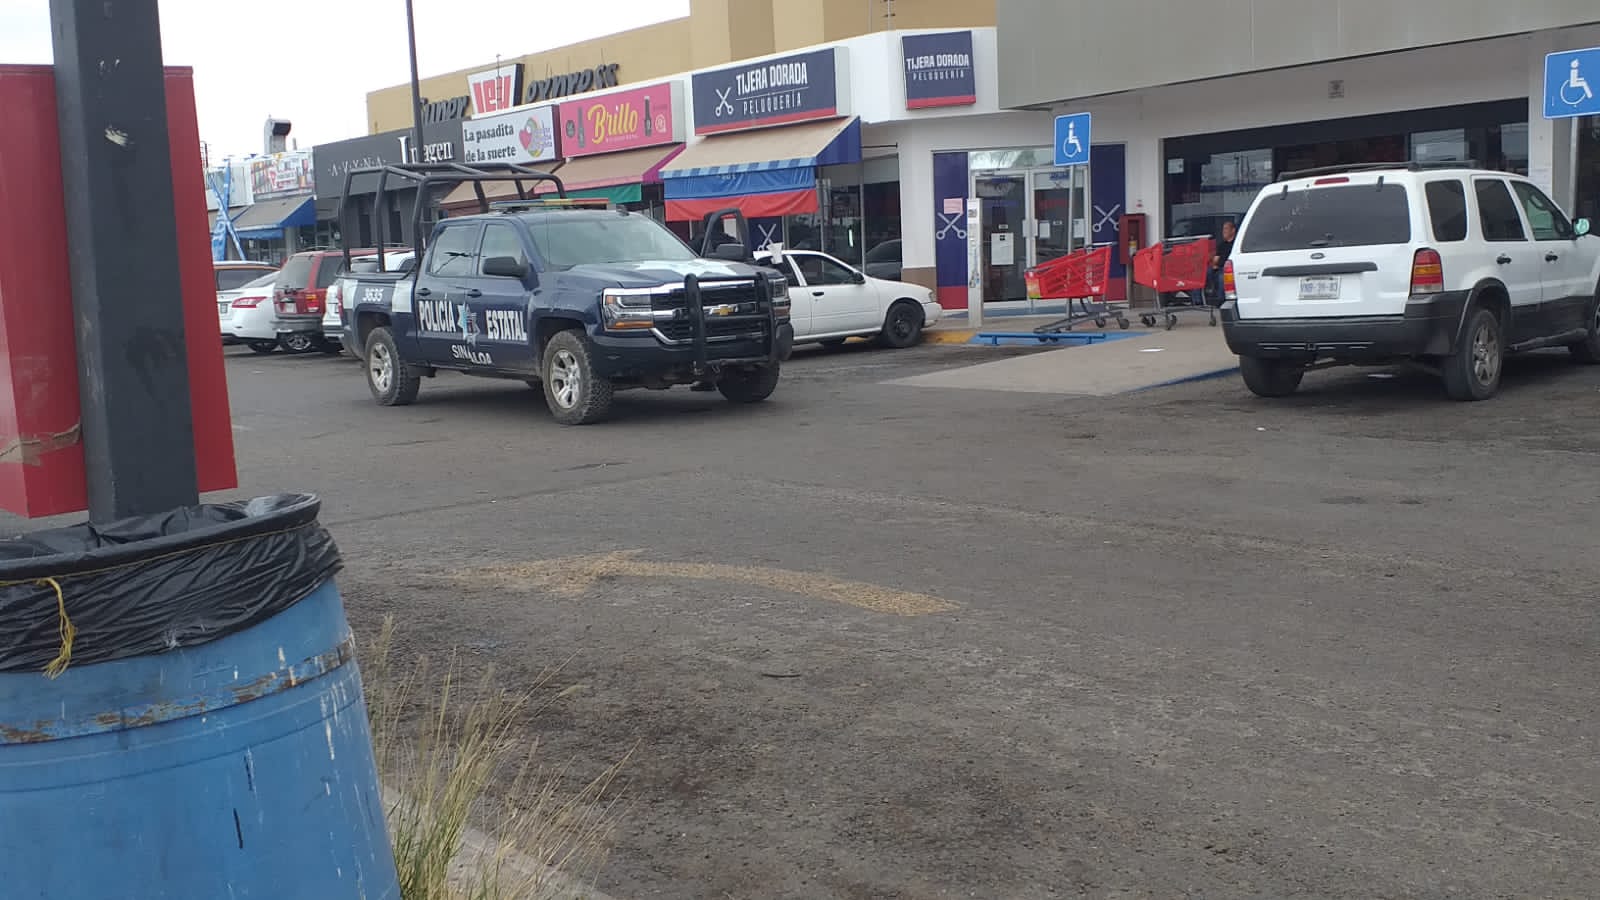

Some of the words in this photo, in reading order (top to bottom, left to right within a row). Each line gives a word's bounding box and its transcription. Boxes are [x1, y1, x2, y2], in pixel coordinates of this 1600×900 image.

[907, 56, 935, 70] TIJERA
[936, 54, 969, 66] DORADA
[736, 67, 768, 96] TIJERA
[770, 62, 808, 86] DORADA
[464, 129, 475, 142] La
[476, 124, 514, 143] pasadita
[587, 103, 638, 144] Brillo
[466, 150, 476, 162] de
[477, 149, 486, 161] la
[488, 146, 516, 160] suerte
[418, 293, 456, 332] POLICÍA
[485, 310, 528, 341] ESTATAL
[451, 344, 492, 365] SINALOA
